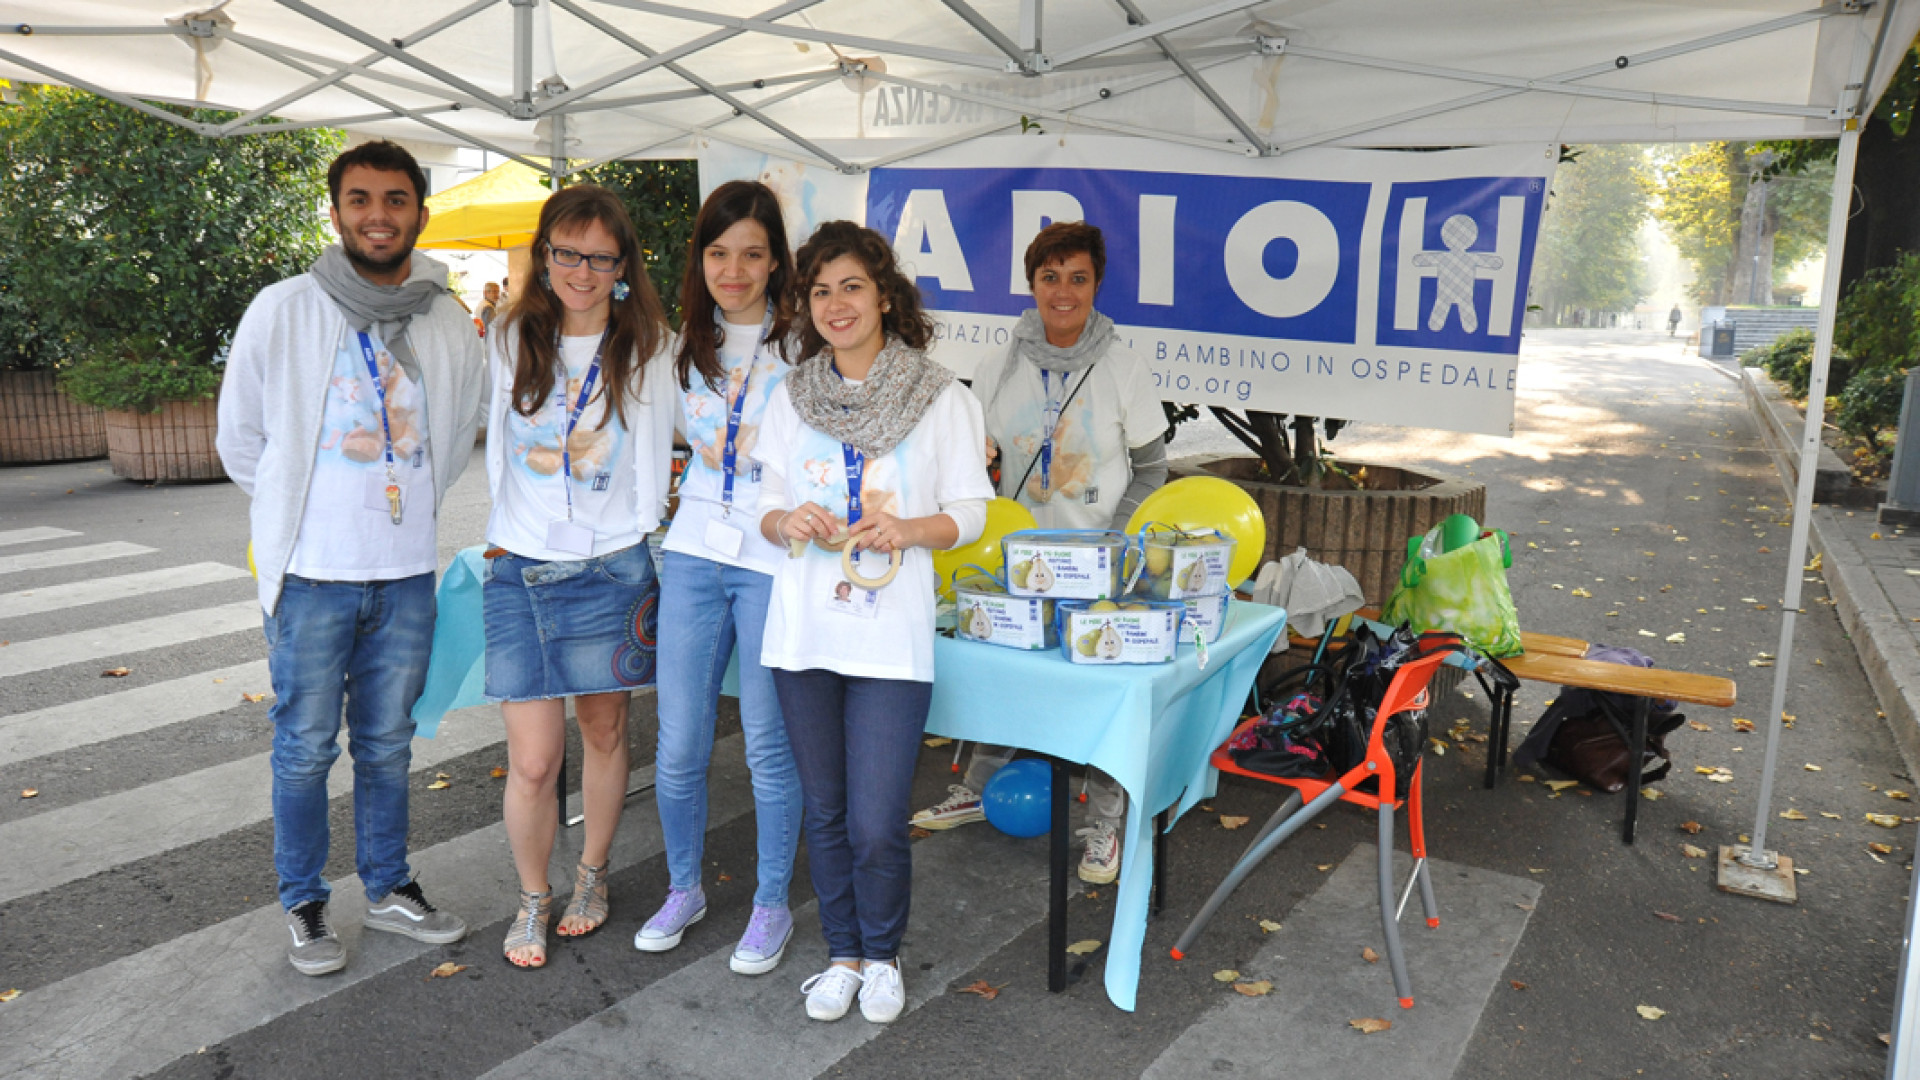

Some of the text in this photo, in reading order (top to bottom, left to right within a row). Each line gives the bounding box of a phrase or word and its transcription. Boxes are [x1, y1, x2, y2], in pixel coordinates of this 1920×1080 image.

[933, 322, 1009, 345] CIAZIO
[1156, 341, 1290, 372] BAMBINO
[1306, 354, 1334, 376] IN
[1351, 358, 1516, 391] OSPEDALE
